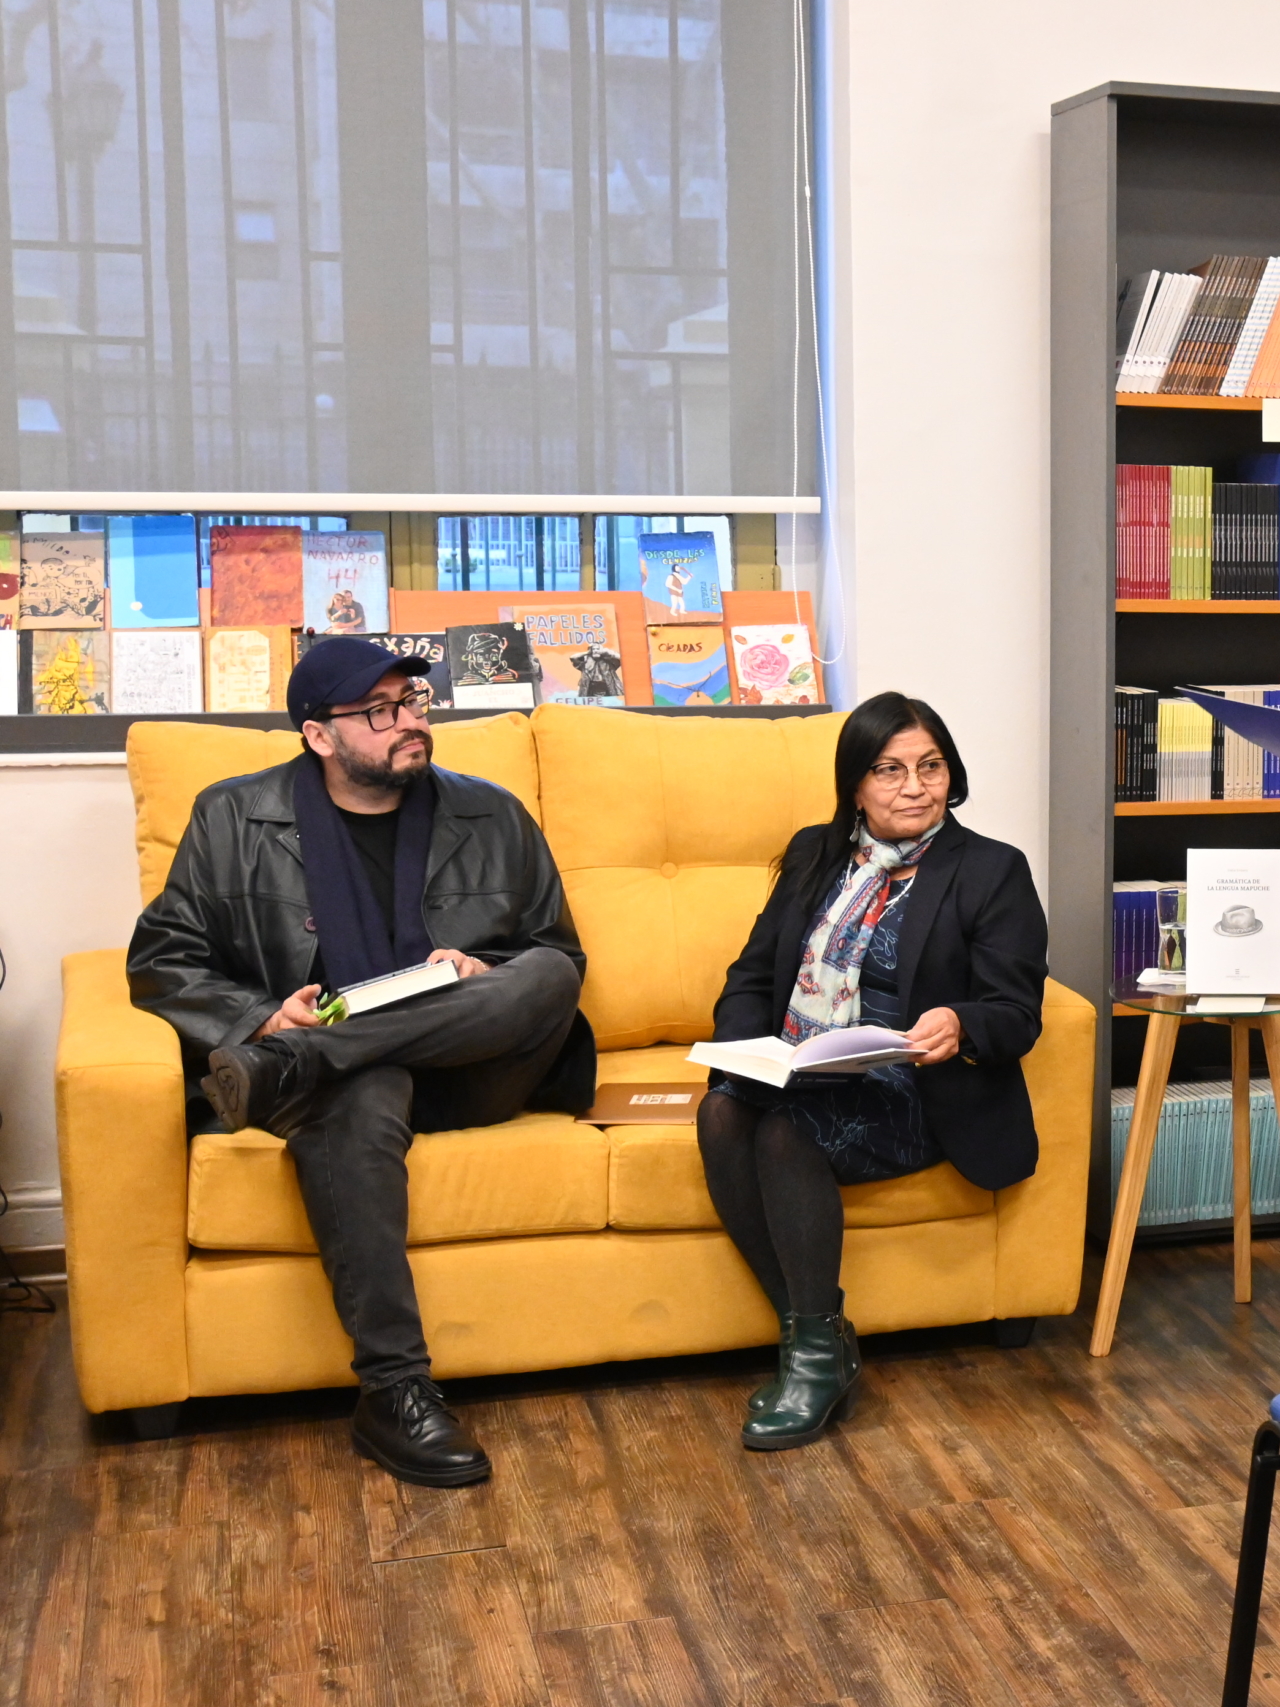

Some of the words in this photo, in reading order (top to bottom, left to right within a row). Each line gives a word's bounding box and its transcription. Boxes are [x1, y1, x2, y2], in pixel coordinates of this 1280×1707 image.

[307, 533, 368, 548] HECTOR
[307, 550, 379, 565] NAVARRO
[644, 550, 680, 560] DESDE
[525, 614, 604, 630] PAPELES
[527, 630, 607, 646] FALLIDOS
